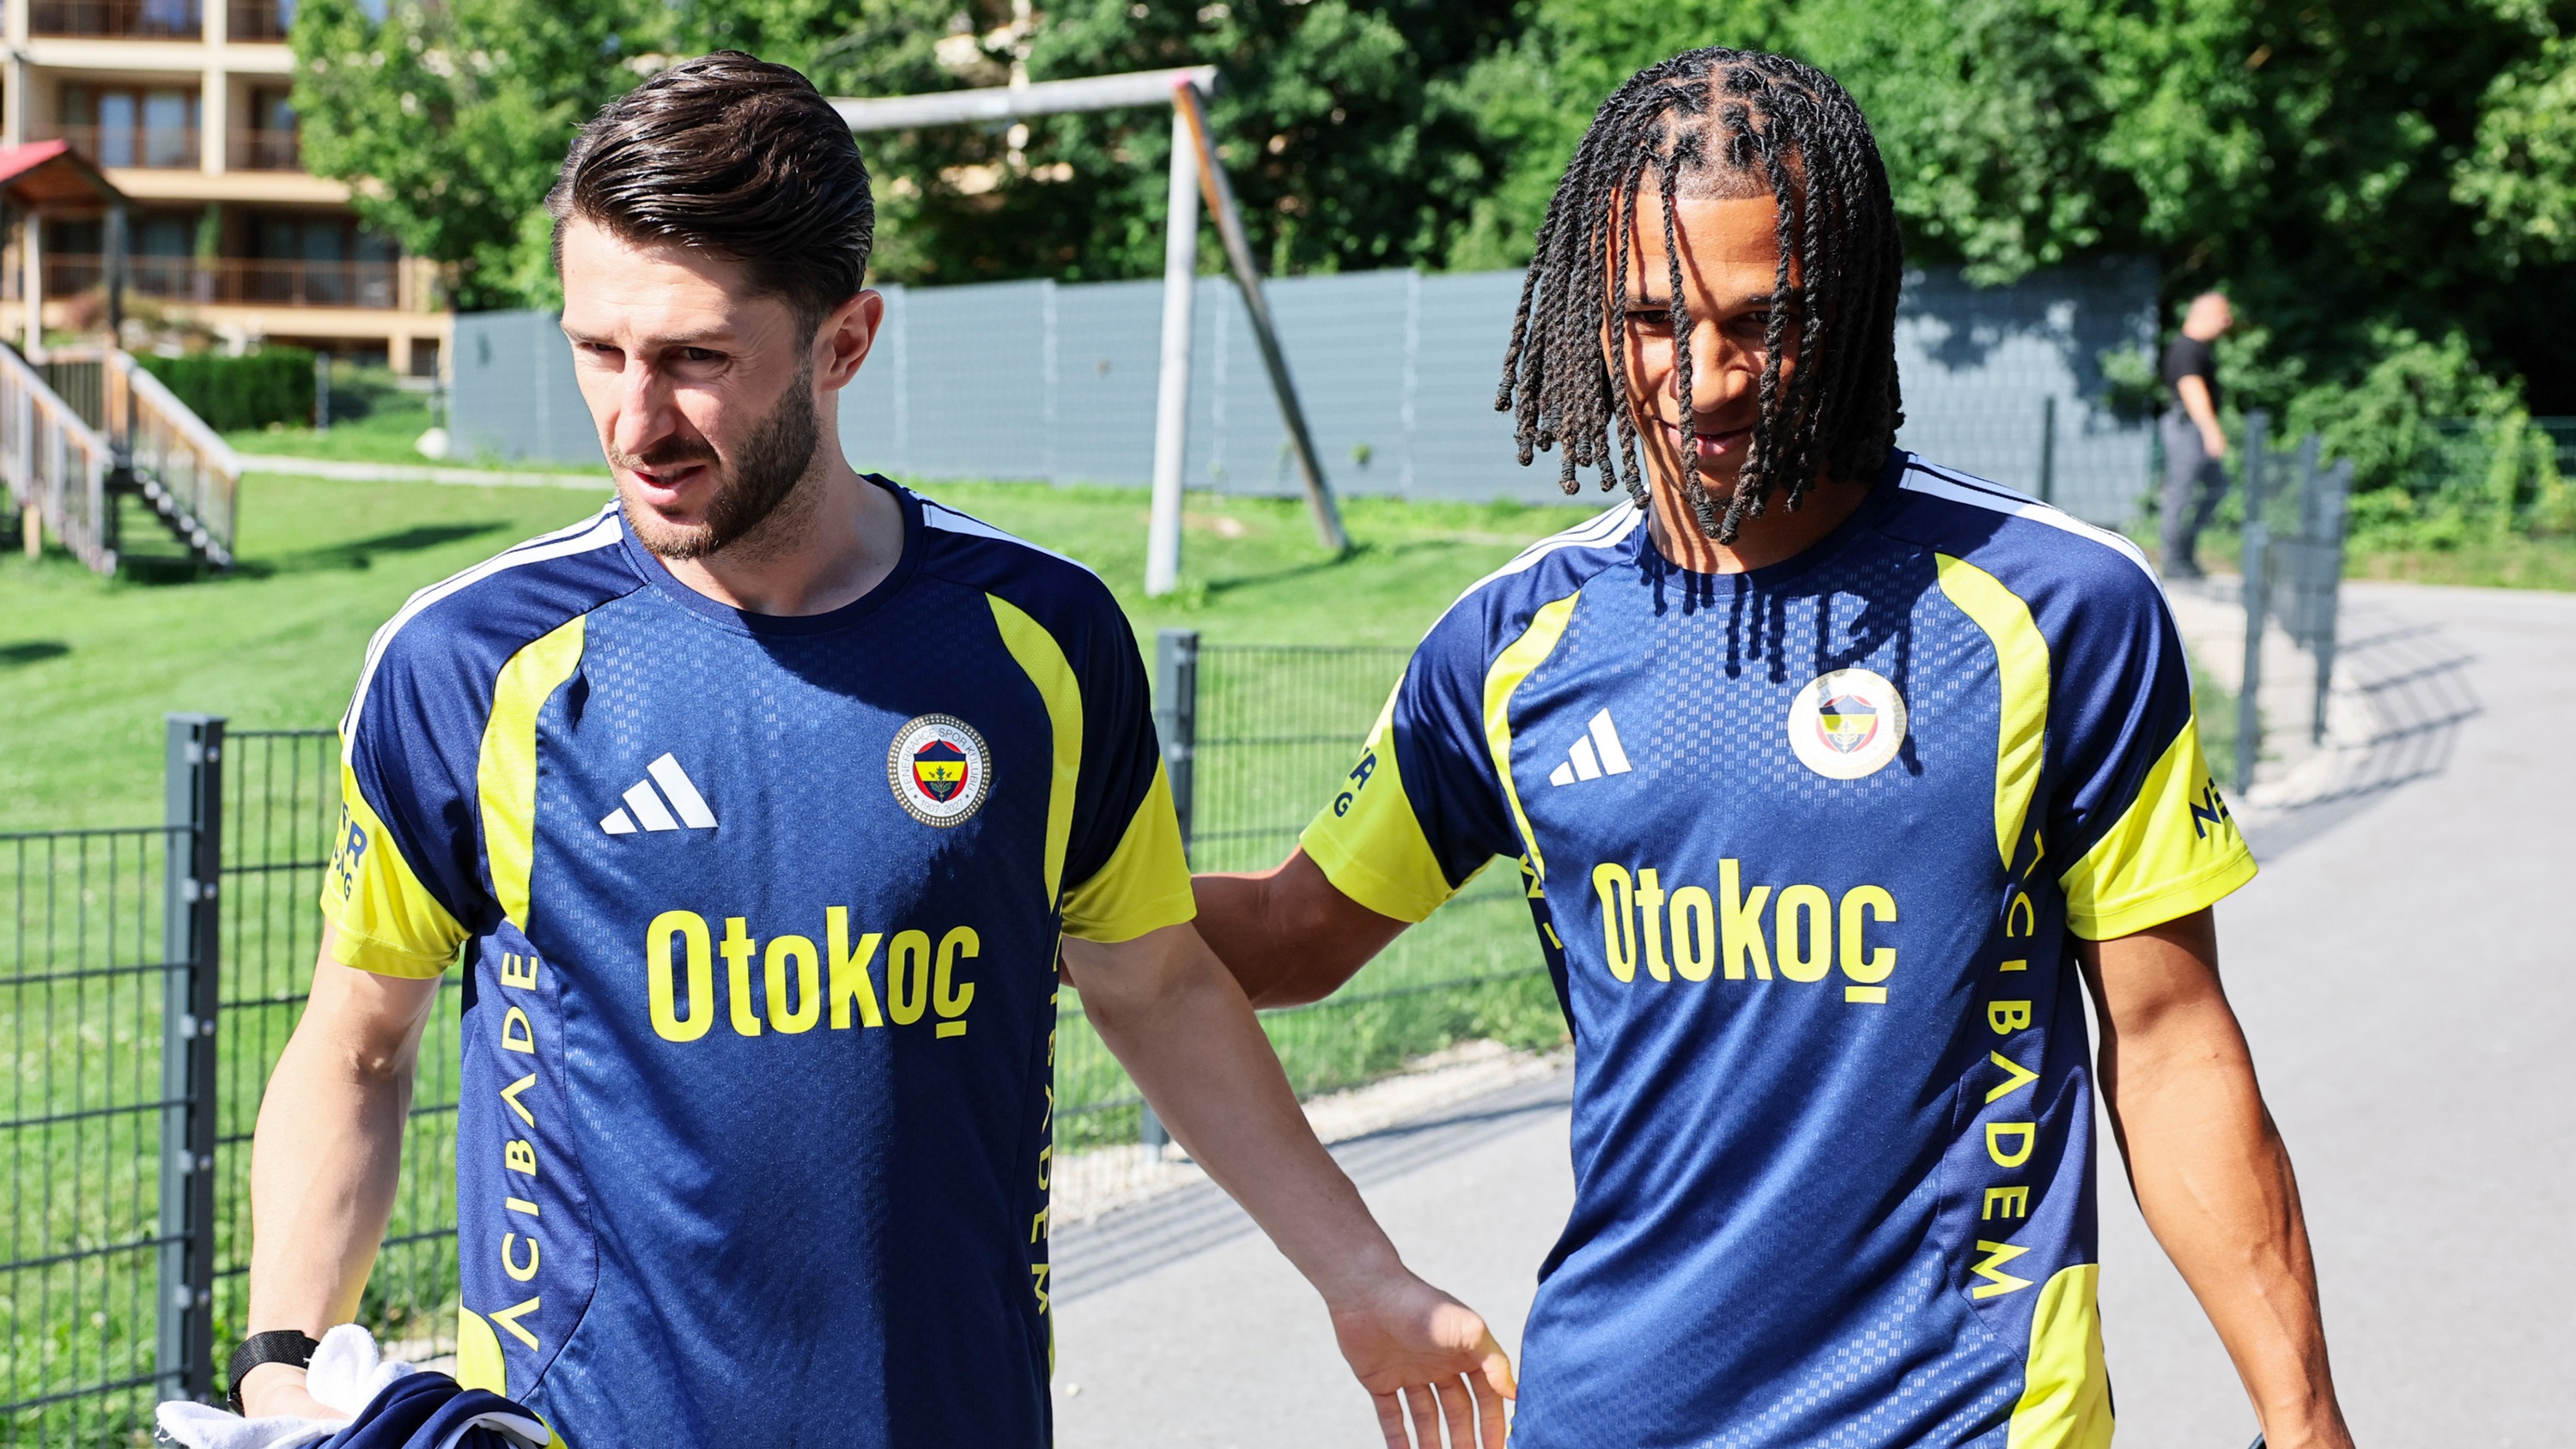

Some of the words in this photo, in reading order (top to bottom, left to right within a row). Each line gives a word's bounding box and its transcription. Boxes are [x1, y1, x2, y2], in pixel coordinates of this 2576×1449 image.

[902, 728, 936, 791] FENERBAHÇE
[939, 727, 968, 748] SPOR
[488, 951, 540, 1353] ACIBADE
